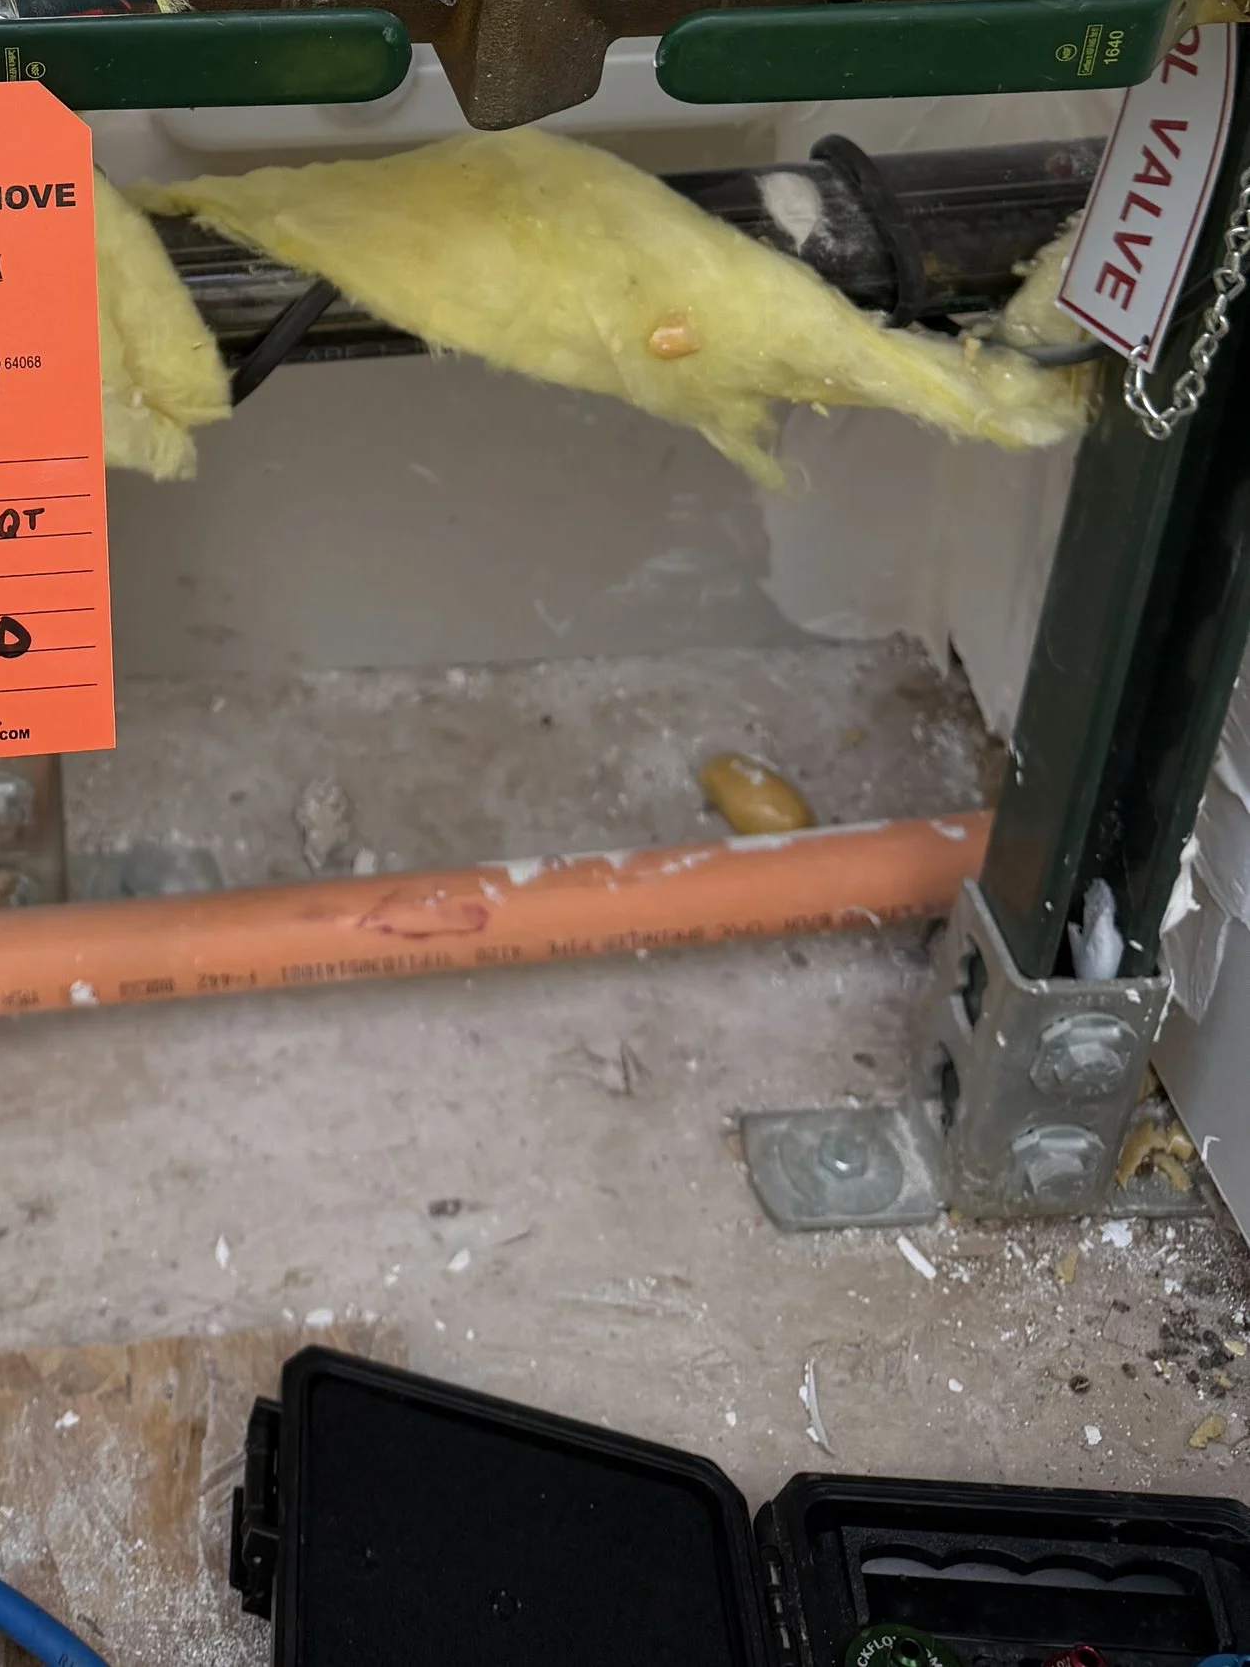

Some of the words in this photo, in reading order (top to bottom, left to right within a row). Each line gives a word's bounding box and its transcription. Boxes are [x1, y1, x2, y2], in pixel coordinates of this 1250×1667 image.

[1103, 30, 1125, 65] 1640
[1095, 118, 1189, 311] VALVE
[4, 355, 42, 370] 64068
